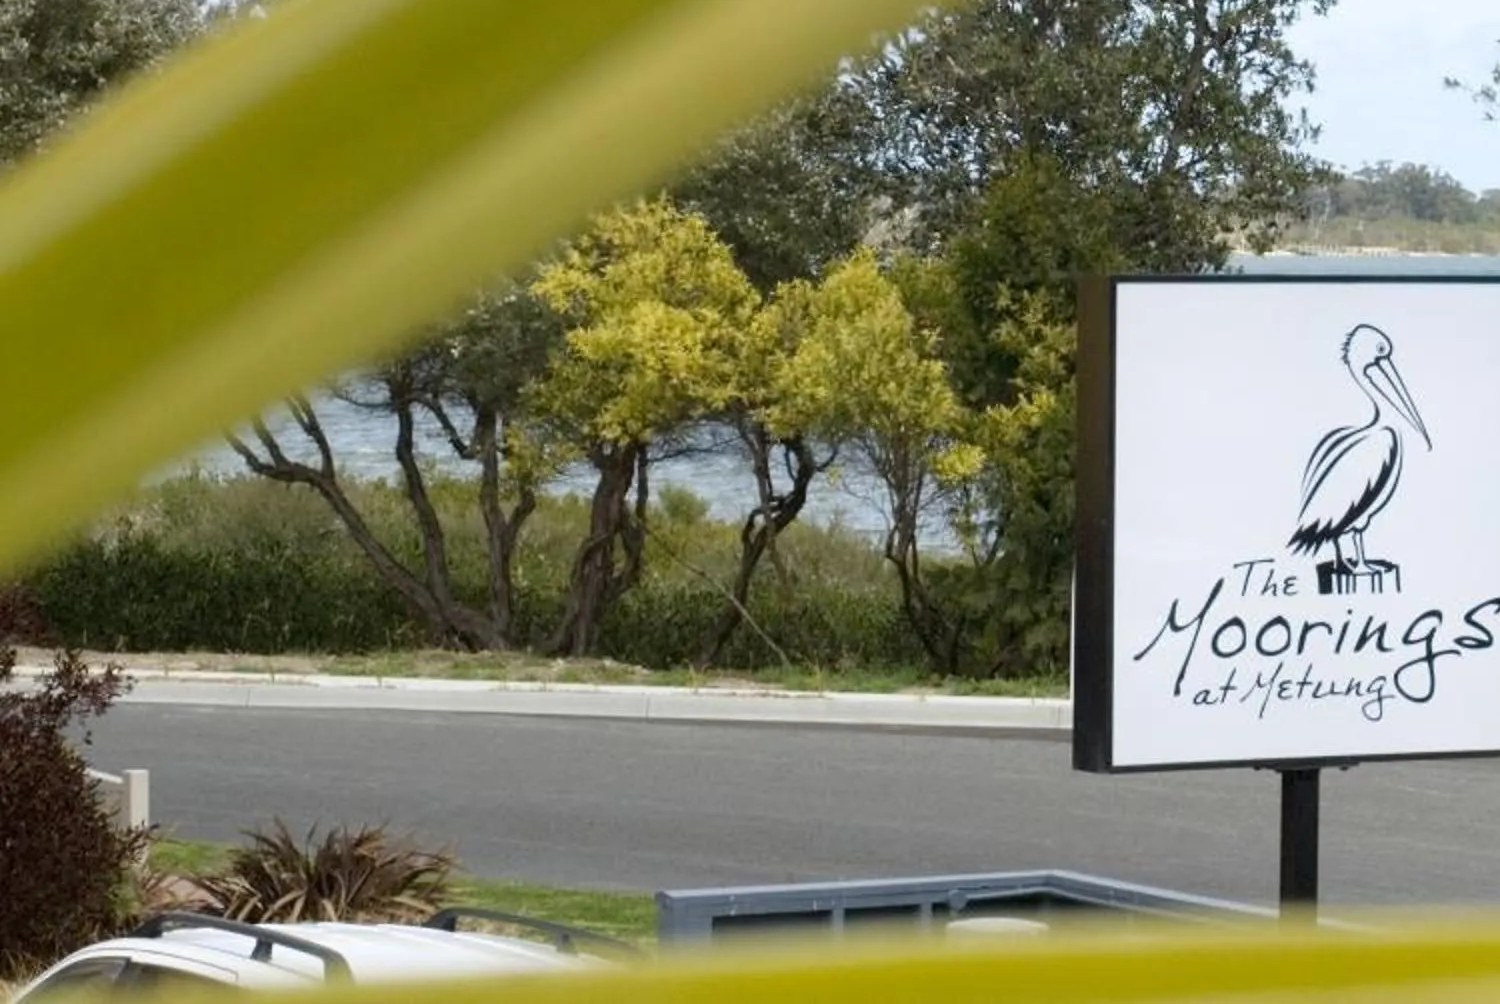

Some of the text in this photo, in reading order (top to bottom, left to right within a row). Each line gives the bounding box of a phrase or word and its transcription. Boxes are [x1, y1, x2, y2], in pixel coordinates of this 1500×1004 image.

[1233, 558, 1299, 597] The
[1192, 662, 1396, 722] at Metung
